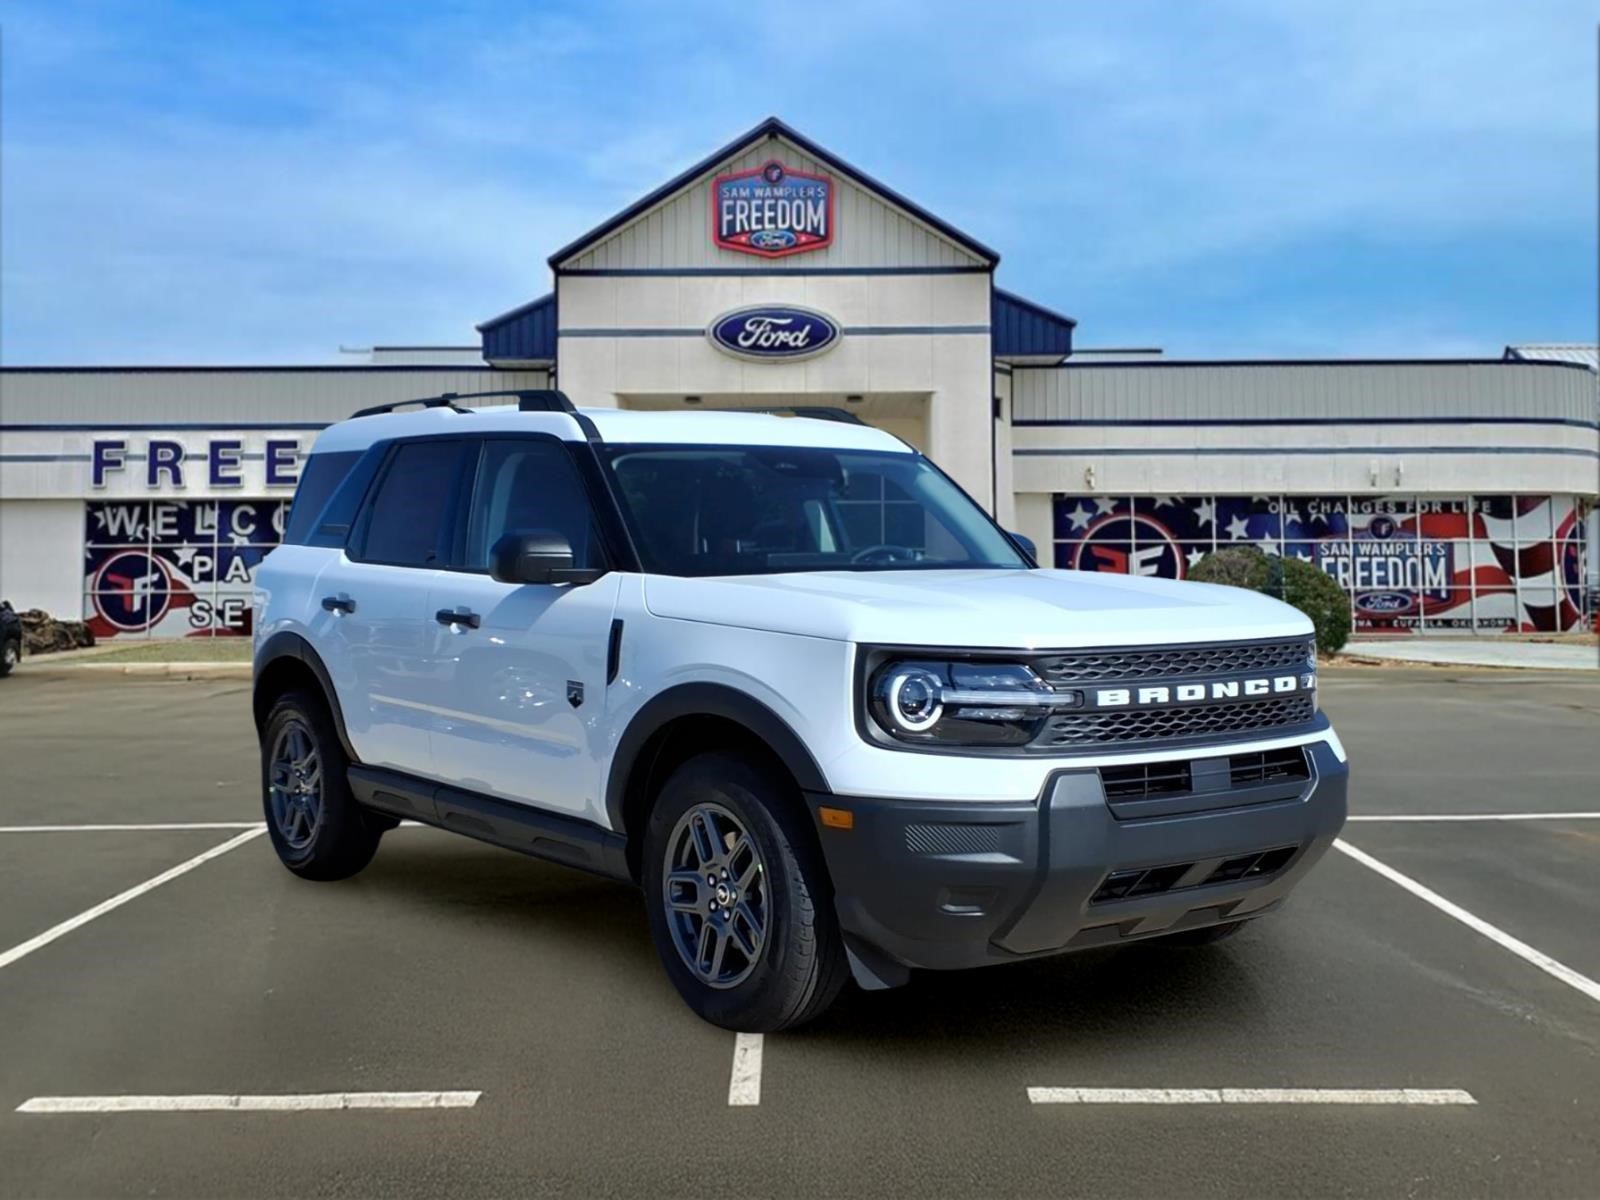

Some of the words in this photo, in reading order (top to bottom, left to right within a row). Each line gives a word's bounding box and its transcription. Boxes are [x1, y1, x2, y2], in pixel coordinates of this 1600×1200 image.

[723, 187, 750, 198] SAM
[722, 199, 825, 236] FREEDOM
[737, 316, 811, 347] Ford
[1268, 502, 1298, 513] OIL
[1307, 502, 1397, 514] CHANGES
[1405, 501, 1442, 513] FOR
[1451, 501, 1492, 513] LIFE
[1321, 557, 1447, 598] FREEDOM
[191, 601, 244, 626] SE
[1366, 595, 1399, 608] Ford
[1097, 676, 1297, 706] BRONCO
